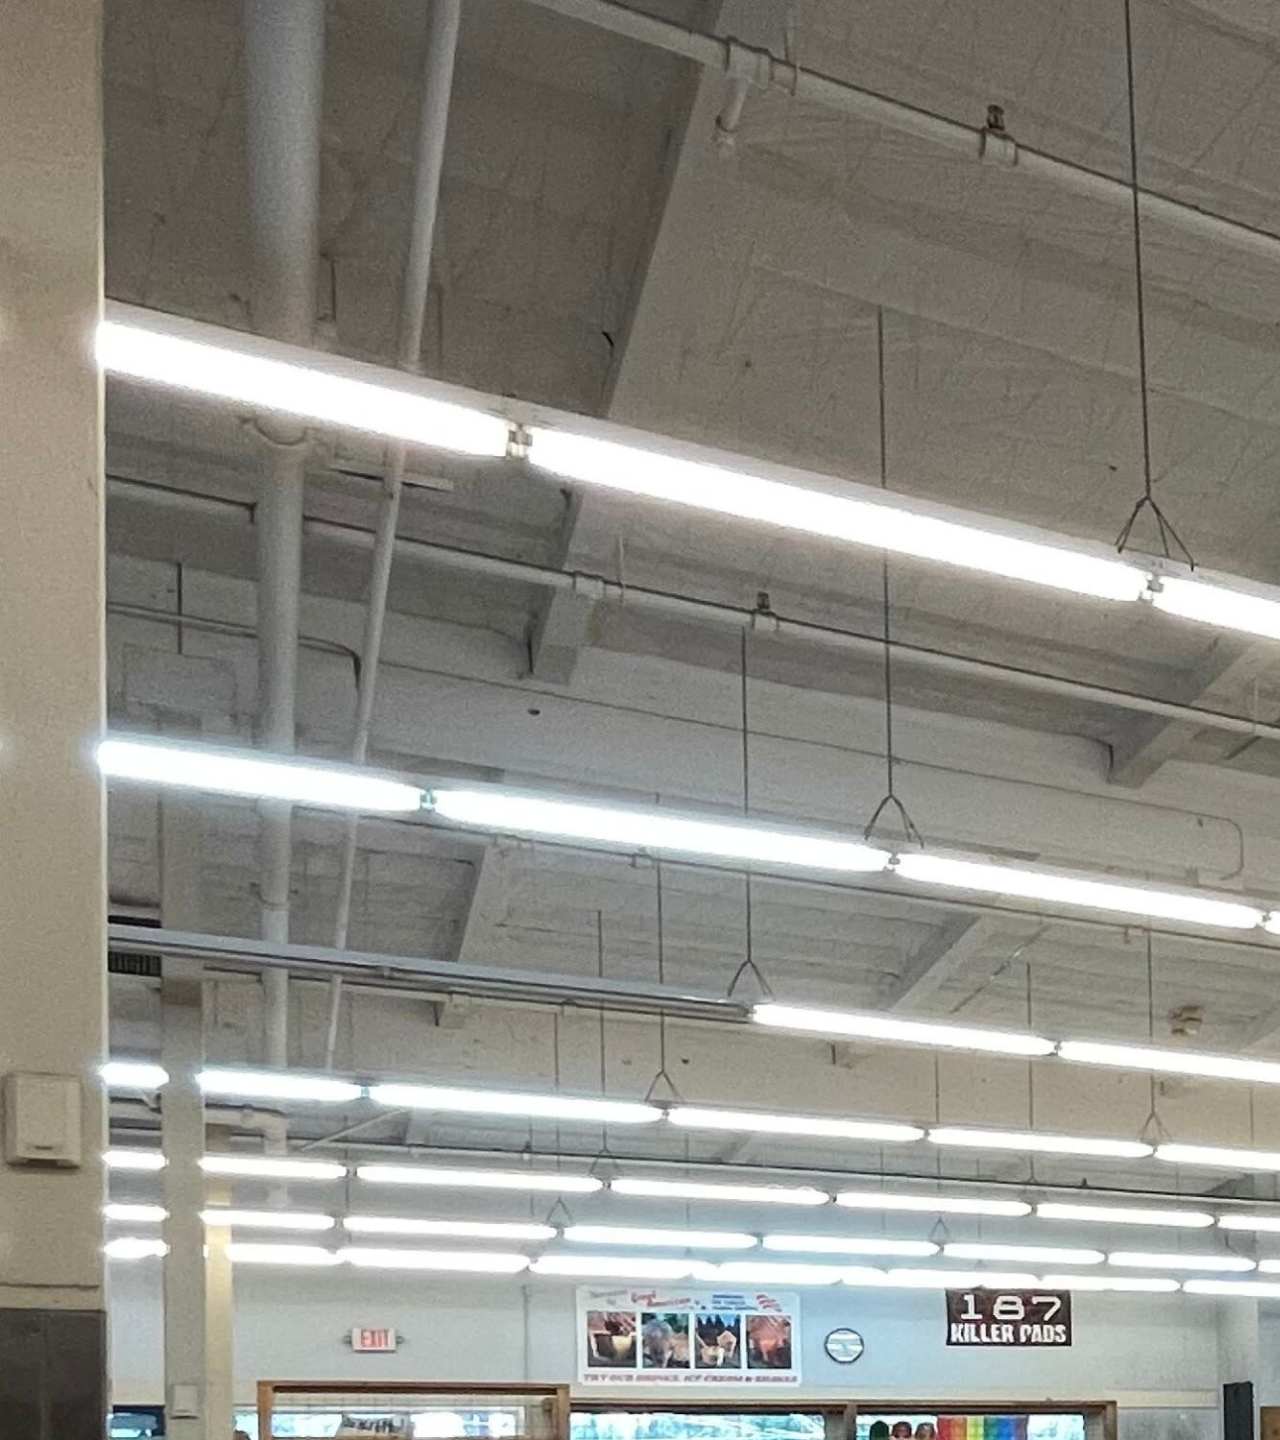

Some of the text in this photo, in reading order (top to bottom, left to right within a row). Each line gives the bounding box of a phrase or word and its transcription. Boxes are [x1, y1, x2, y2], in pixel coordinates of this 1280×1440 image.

[960, 1294, 1061, 1321] 187
[360, 1328, 388, 1347] EXIT
[950, 1322, 1067, 1343] KILLER PADS
